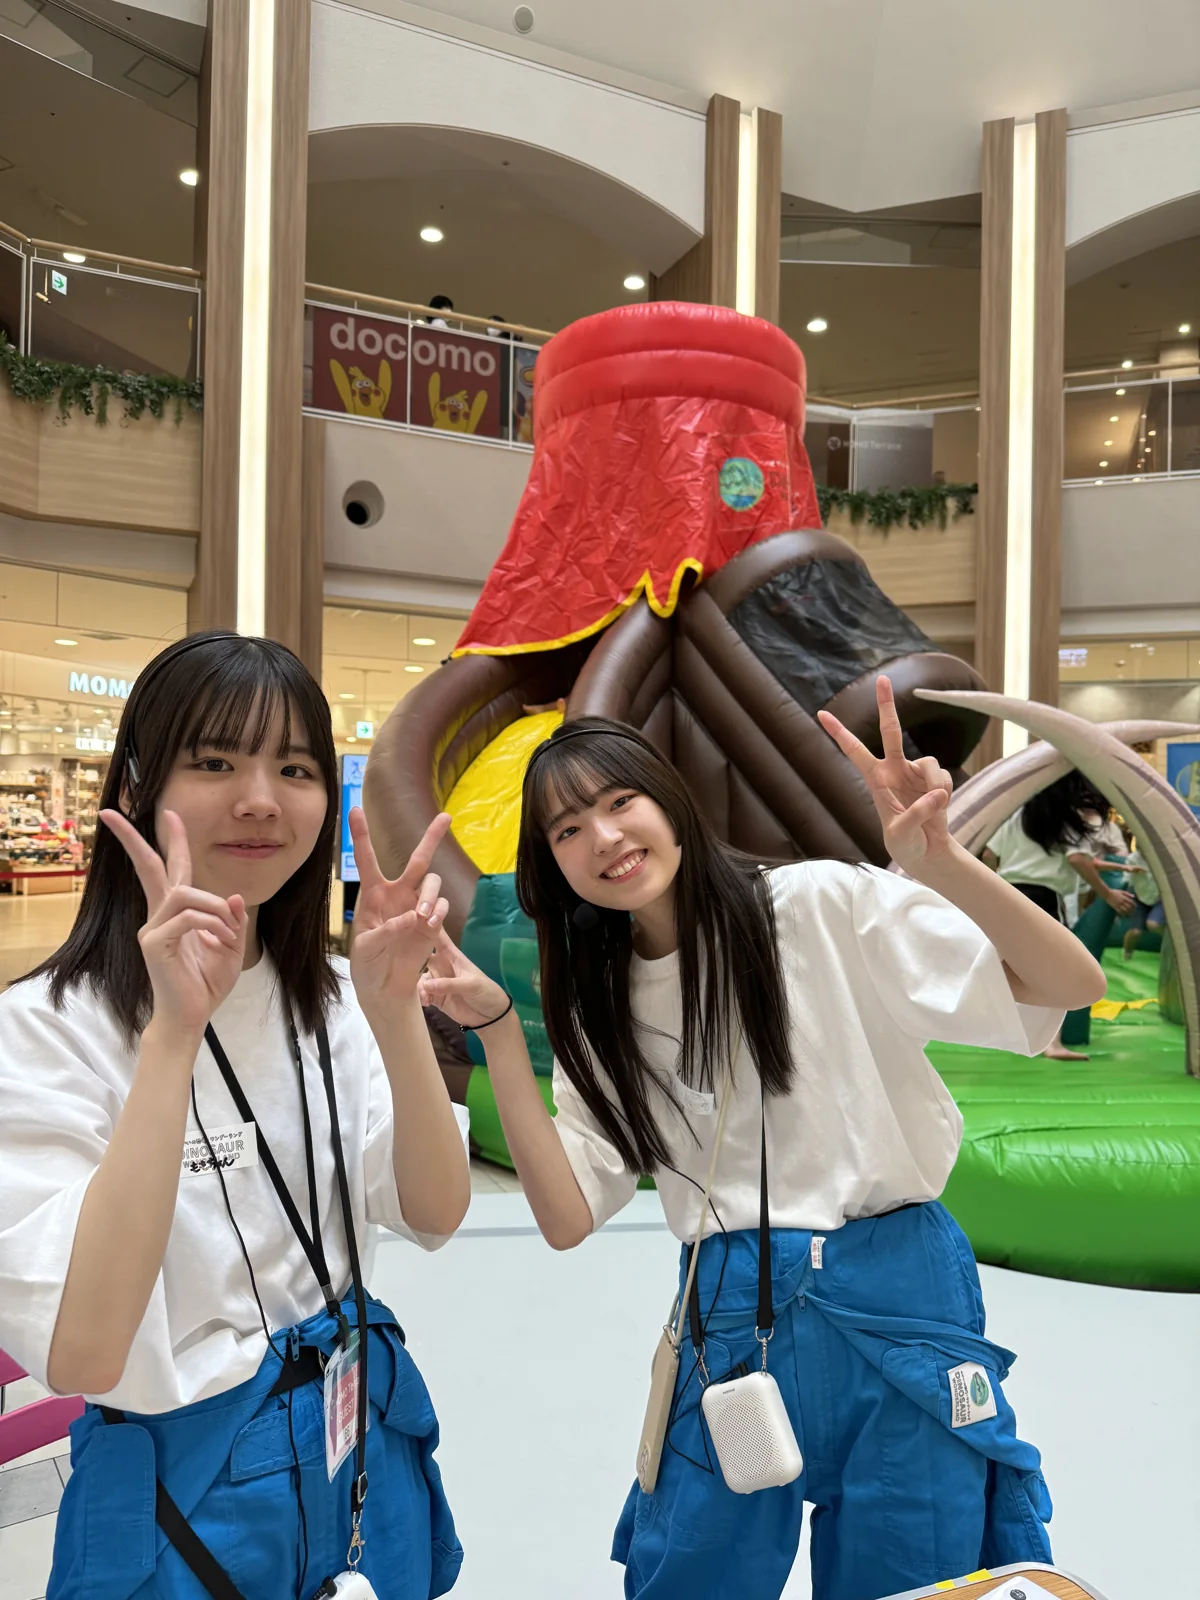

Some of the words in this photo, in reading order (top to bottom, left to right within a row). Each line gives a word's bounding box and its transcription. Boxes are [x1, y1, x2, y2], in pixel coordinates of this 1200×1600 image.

[329, 317, 496, 377] docomo
[182, 1139, 245, 1159] INOSAUR
[954, 1371, 967, 1424] DINOSAUR
